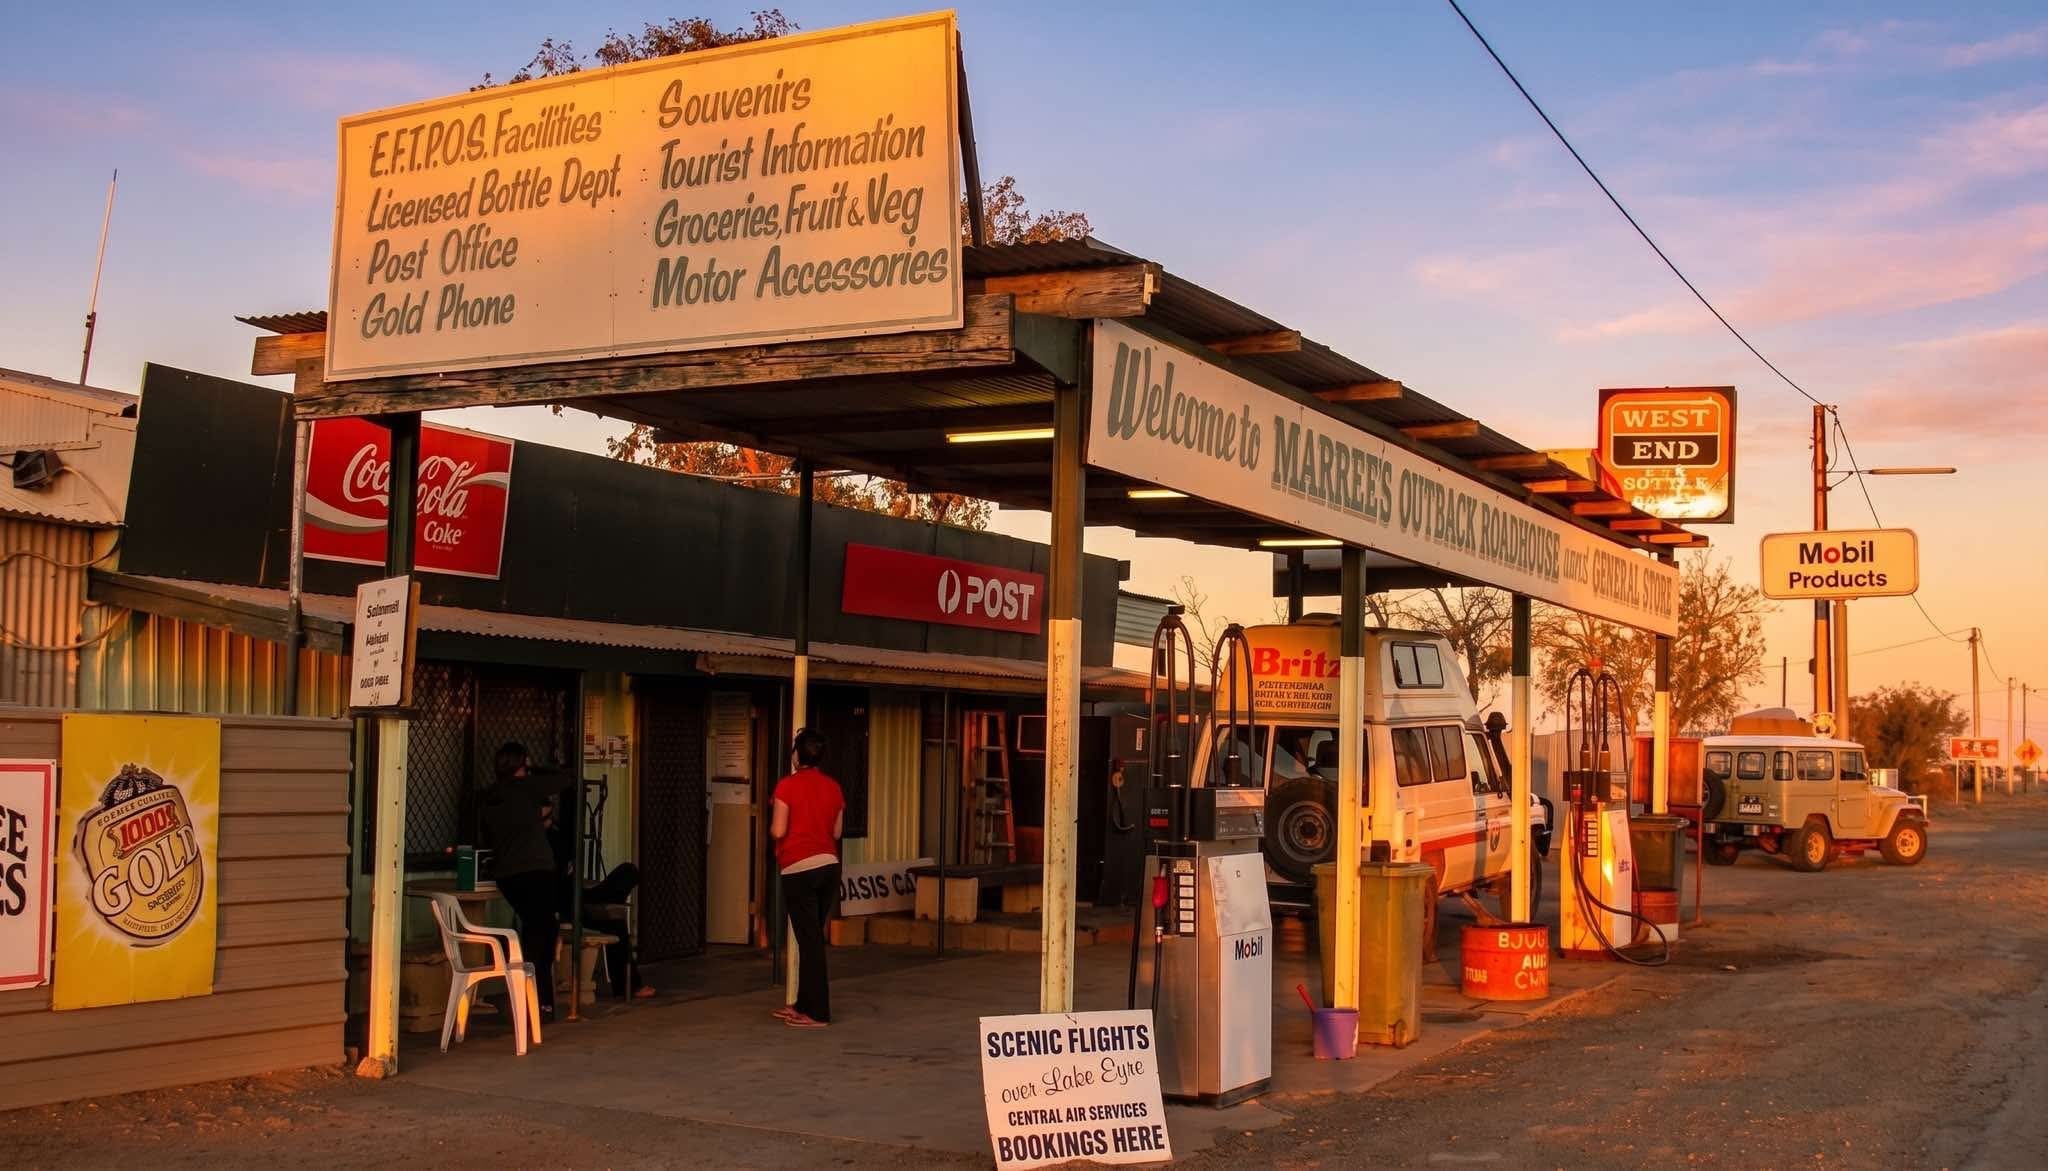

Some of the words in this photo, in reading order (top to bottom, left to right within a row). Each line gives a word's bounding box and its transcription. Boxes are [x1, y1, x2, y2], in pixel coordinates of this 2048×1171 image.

[659, 68, 811, 128] Souvenirs
[493, 102, 601, 156] Facilities
[661, 136, 753, 189] Tourist
[761, 113, 925, 176] Information
[368, 177, 475, 232] Licensed
[478, 166, 552, 216] Bottle
[559, 154, 621, 208] Dept.
[785, 181, 848, 233] Fruit
[867, 173, 923, 235] Veg
[368, 238, 428, 284] Post
[440, 222, 518, 275] Office
[653, 256, 747, 309] Motor
[756, 236, 948, 299] Accessories
[361, 290, 429, 339] Gold
[437, 282, 515, 331] Phone
[1621, 409, 1710, 428] WEST
[1632, 441, 1699, 459] END
[1107, 342, 1237, 462] Welcome
[1240, 404, 1260, 472] to
[1272, 415, 1393, 526] MARREE'S
[1400, 468, 1478, 555] OUTBACK
[1480, 503, 1560, 581] ROADHOUSE
[1593, 548, 1640, 606] GENERAL
[1643, 568, 1673, 616] STORE
[424, 521, 462, 545] Coke
[1799, 540, 1874, 565] Mobil
[966, 576, 1034, 621] POST
[1789, 570, 1887, 589] Products
[0, 862, 27, 916] S
[92, 824, 198, 917] GOLD
[1235, 936, 1263, 961] Mobil
[987, 1029, 1062, 1058] SCENIC
[1068, 1024, 1150, 1054] FLIGHTS
[1001, 1082, 1038, 1104] over
[1041, 1065, 1095, 1096] Lake
[1100, 1057, 1145, 1086] Eyre
[1008, 1109, 1063, 1126] CENTRAL
[1066, 1107, 1087, 1122] AIR
[1089, 1102, 1148, 1121] SERVICES
[998, 1129, 1108, 1162] BOOKINGS
[1111, 1125, 1165, 1153] HERE
